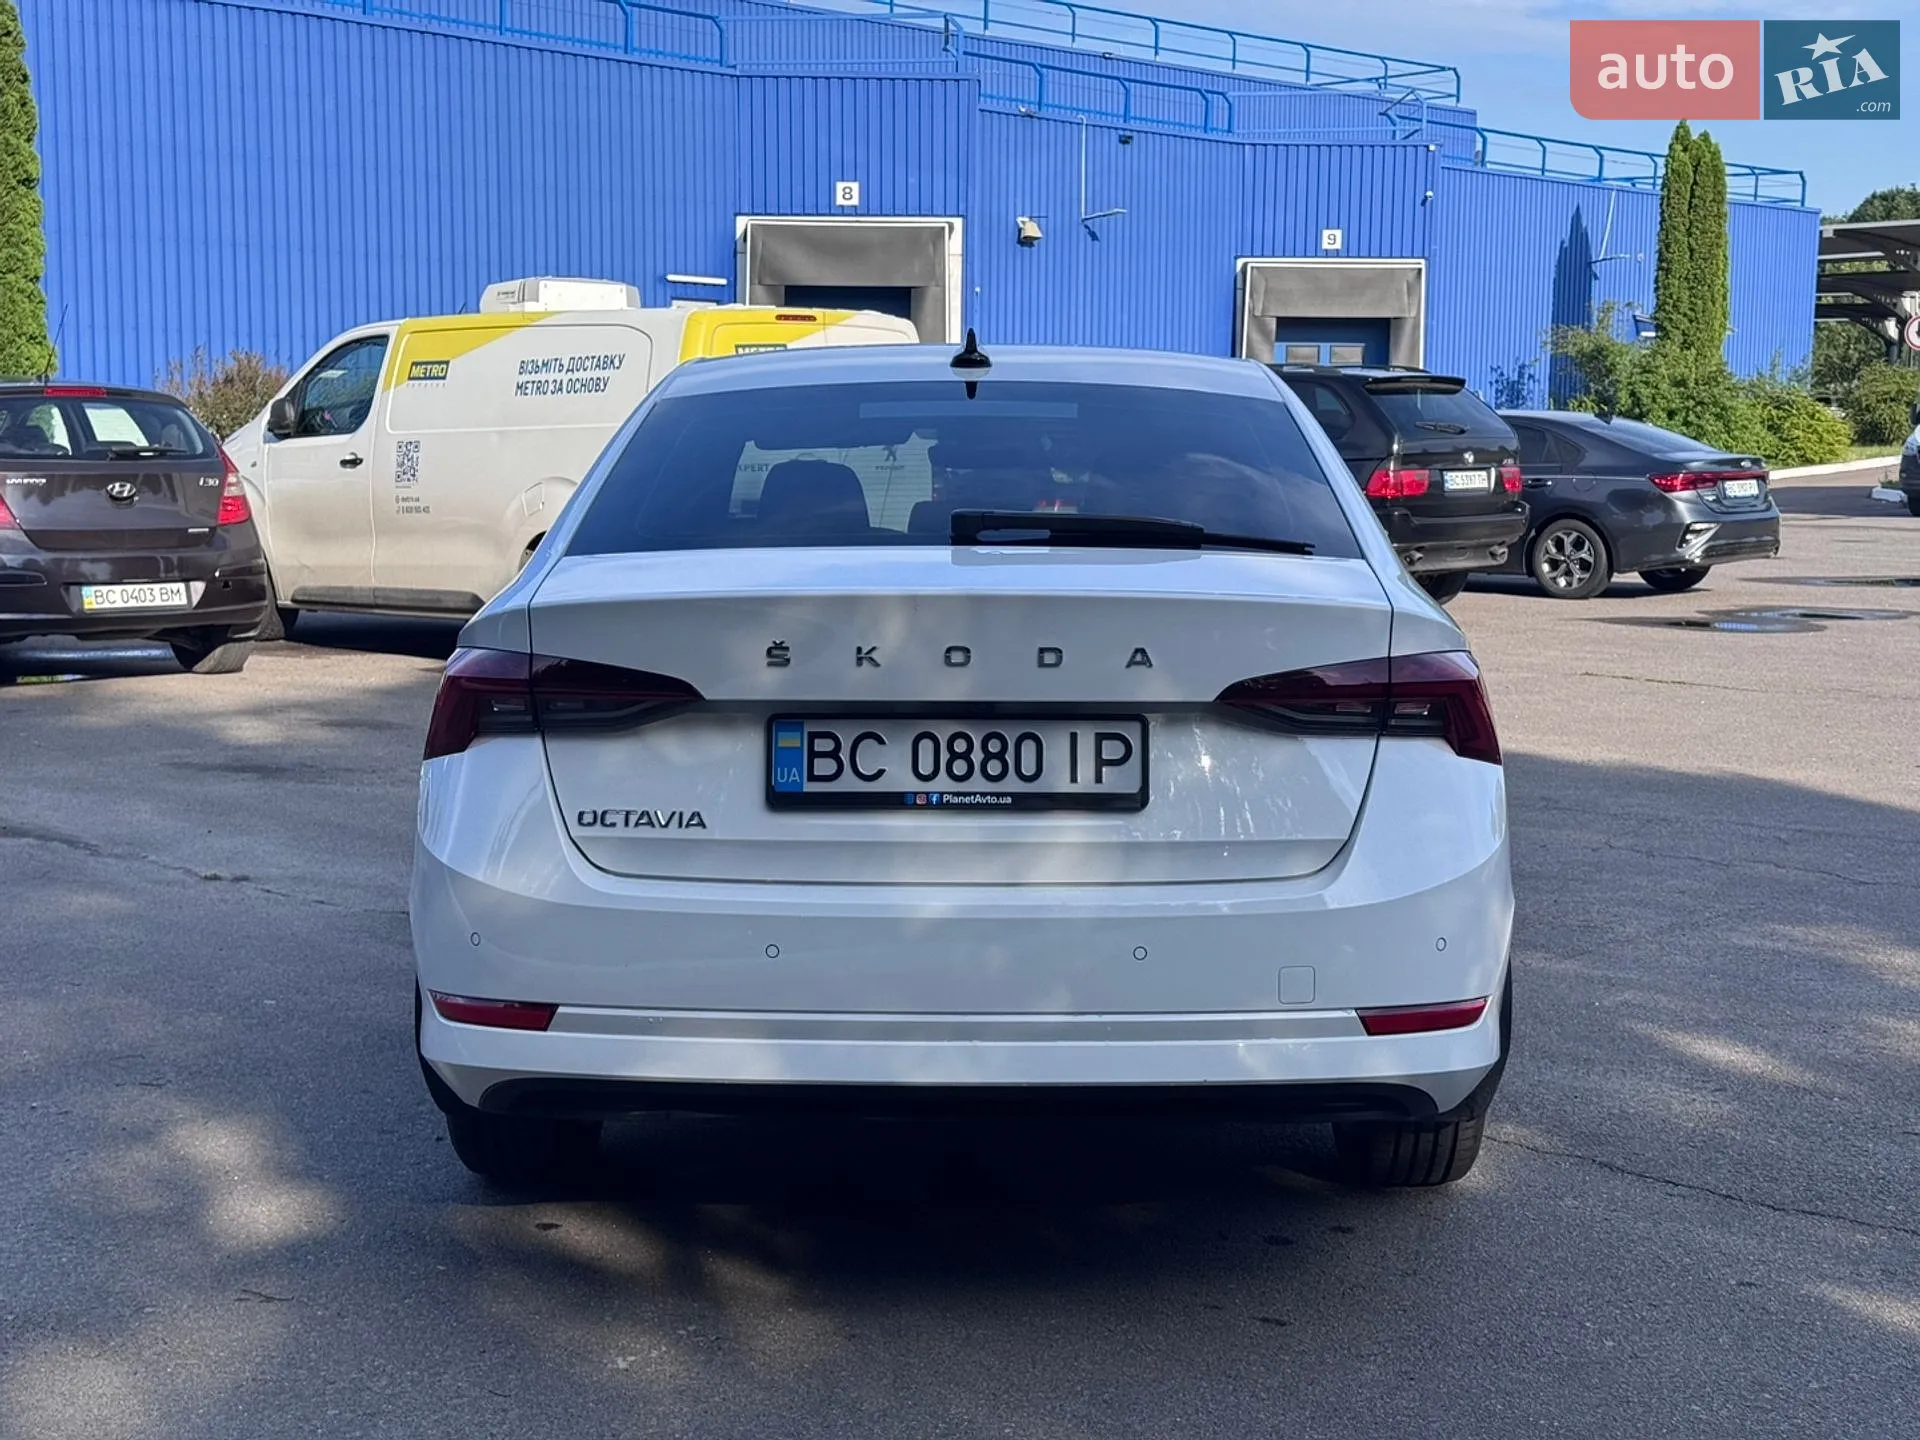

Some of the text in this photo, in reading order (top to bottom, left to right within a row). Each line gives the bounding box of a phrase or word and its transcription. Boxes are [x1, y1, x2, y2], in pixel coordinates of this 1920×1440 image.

[841, 186, 854, 201] 8
[1326, 233, 1337, 246] 9
[410, 364, 447, 378] METRO
[518, 353, 626, 375] ВІЗЬМІТЬ ДОСТАВКУ
[514, 376, 610, 396] METRO ЗА ОСНОВУ
[93, 586, 183, 605] BC 0403 BM
[766, 641, 1154, 669] ŠKODA
[776, 730, 1133, 785] UA BC 0880 IP
[942, 793, 1013, 804] PlanetAvto.ua
[577, 809, 707, 829] OCTAVIA
